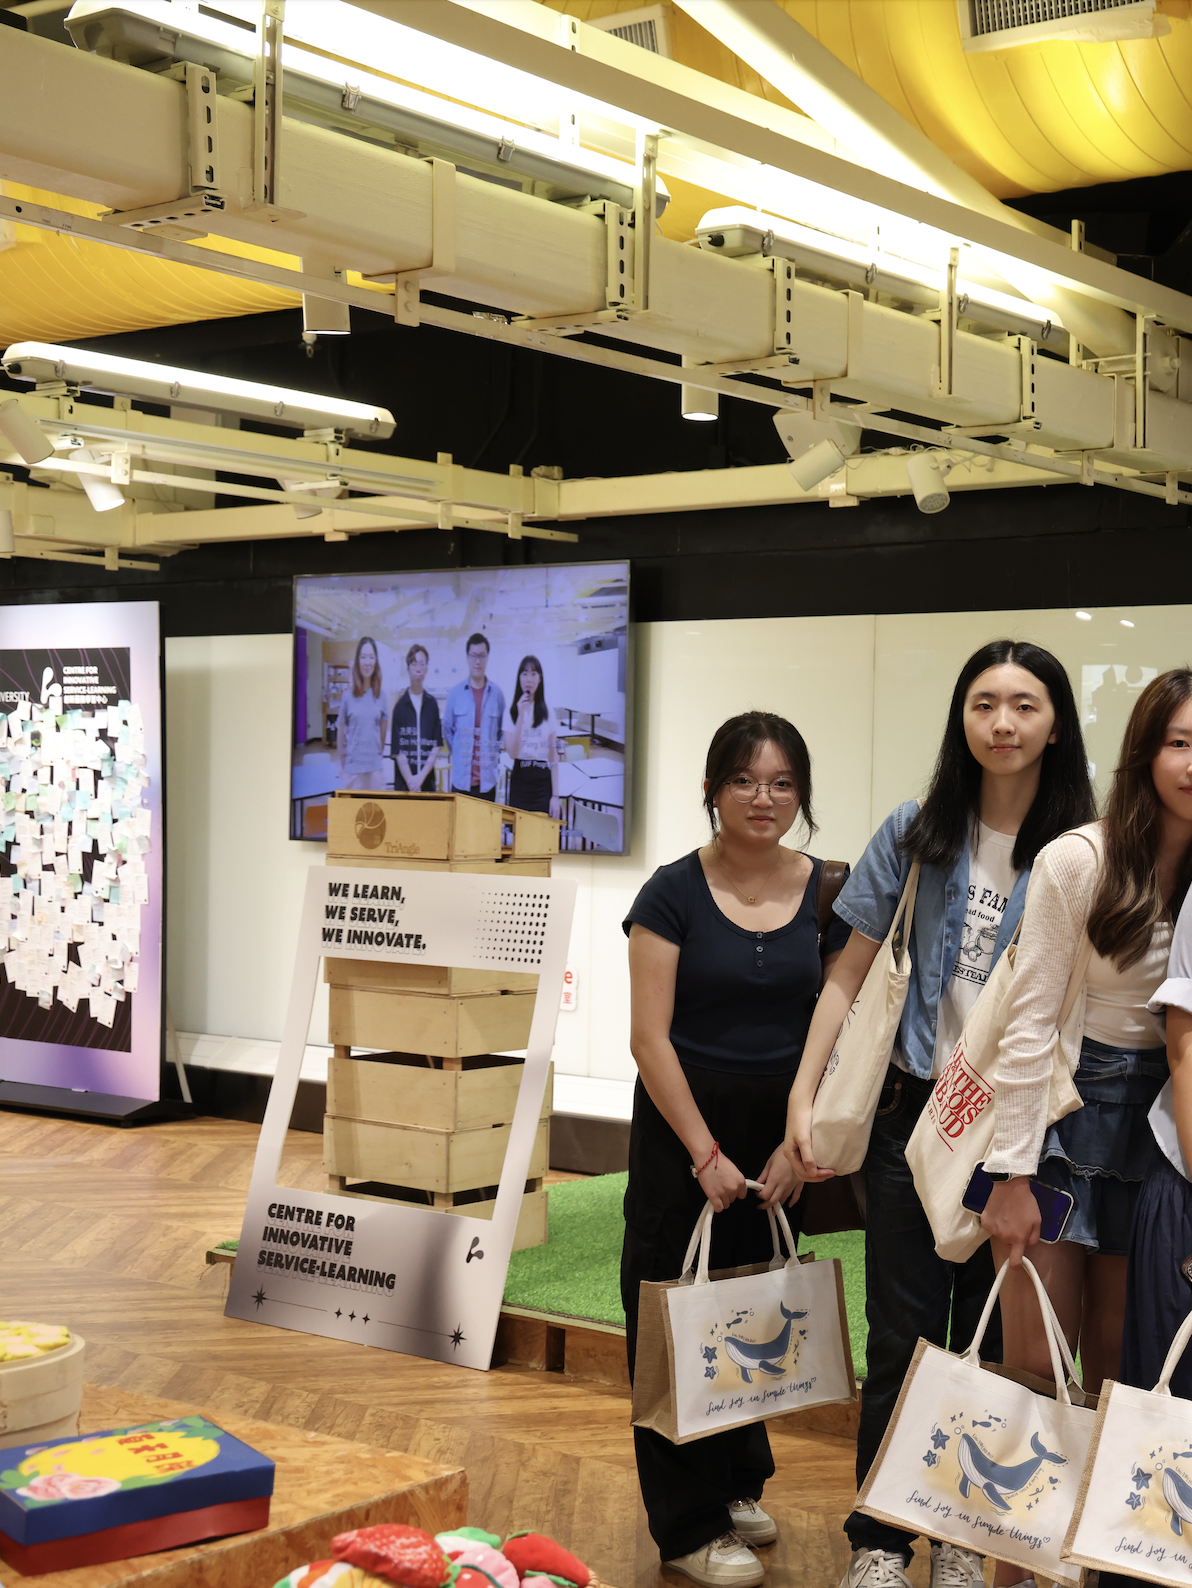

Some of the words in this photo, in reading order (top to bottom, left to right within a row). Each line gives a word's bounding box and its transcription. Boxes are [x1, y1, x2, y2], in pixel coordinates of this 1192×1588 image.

[384, 840, 421, 856] TriAngle
[328, 882, 350, 898] WE
[353, 884, 406, 904] LEARN,
[324, 904, 346, 920] WE
[350, 906, 399, 927] SERVE,
[977, 909, 995, 922] food
[321, 927, 343, 943] WE
[267, 1203, 323, 1226] CENTRE
[326, 1212, 356, 1232] FOR
[262, 1226, 353, 1256] INNOVATIVE
[257, 1250, 397, 1290] SERVICE-LEARNING
[933, 1502, 952, 1518] joy
[954, 1511, 971, 1523] in
[1145, 1543, 1167, 1562] joy
[1169, 1551, 1188, 1564] in
